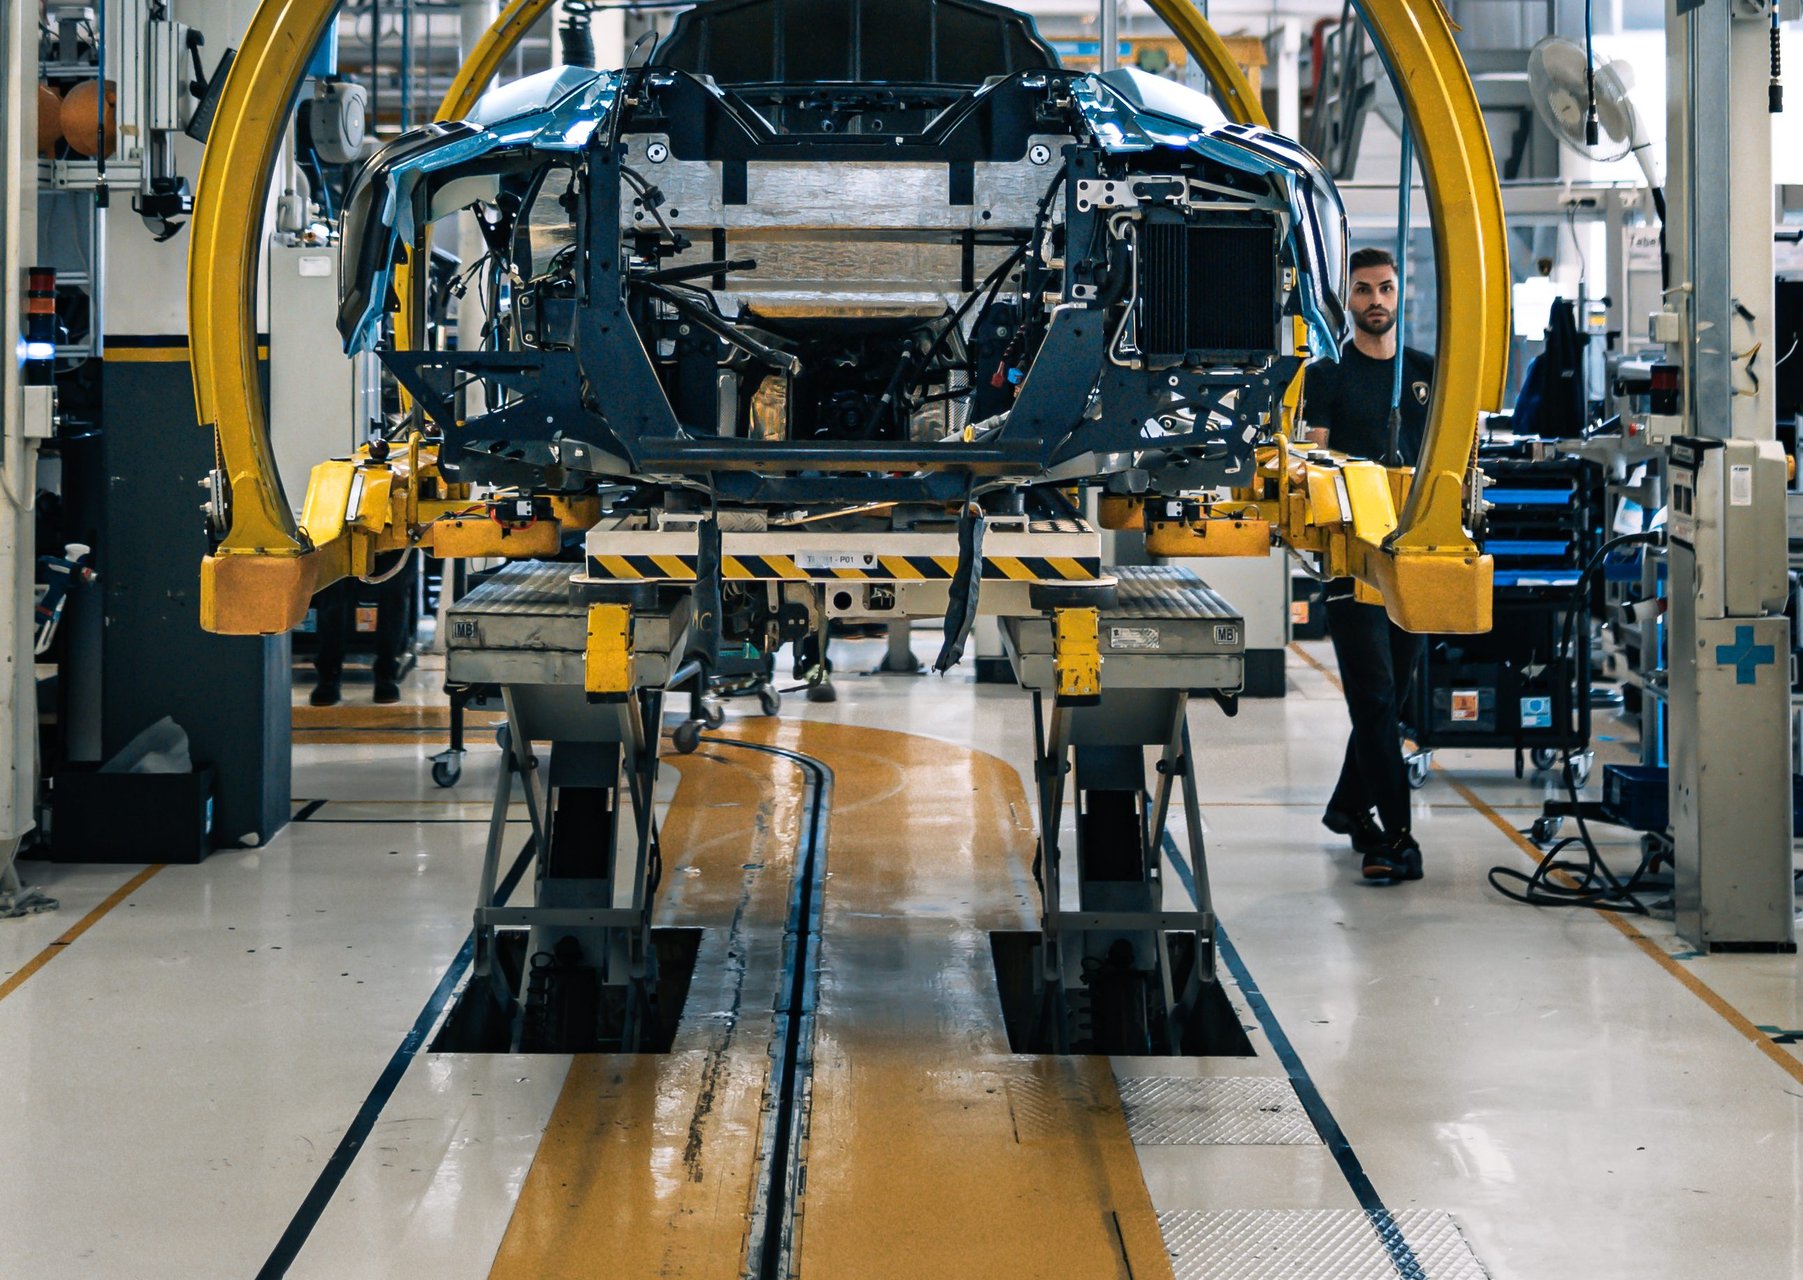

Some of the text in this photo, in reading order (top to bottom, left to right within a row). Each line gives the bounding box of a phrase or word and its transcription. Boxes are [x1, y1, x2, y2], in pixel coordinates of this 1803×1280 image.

[840, 555, 854, 563] P01
[457, 623, 473, 636] MB
[1218, 628, 1234, 640] MB
